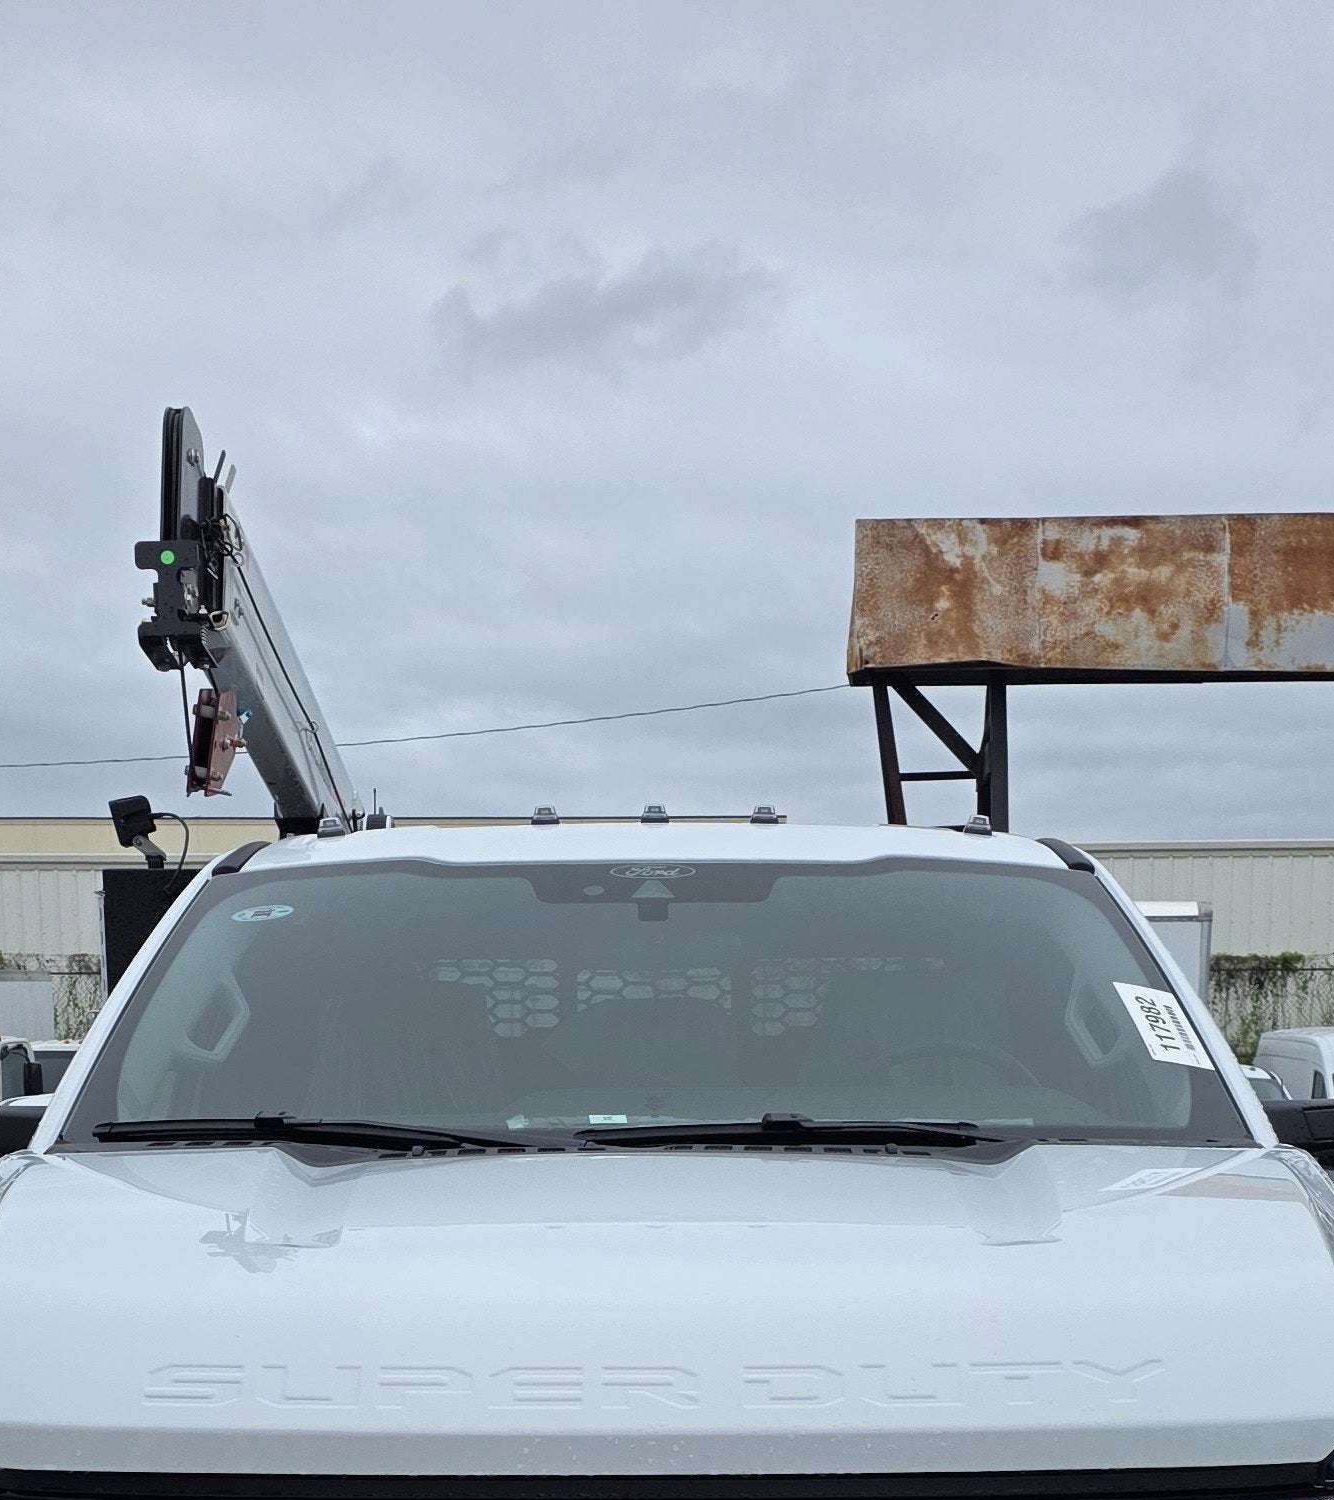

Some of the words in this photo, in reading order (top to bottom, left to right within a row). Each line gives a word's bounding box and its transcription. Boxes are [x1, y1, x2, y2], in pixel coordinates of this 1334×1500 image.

[625, 865, 681, 877] Ford
[1134, 996, 1181, 1051] 117982
[141, 1364, 699, 1409] SUPER
[742, 1358, 1167, 1409] DUTY
